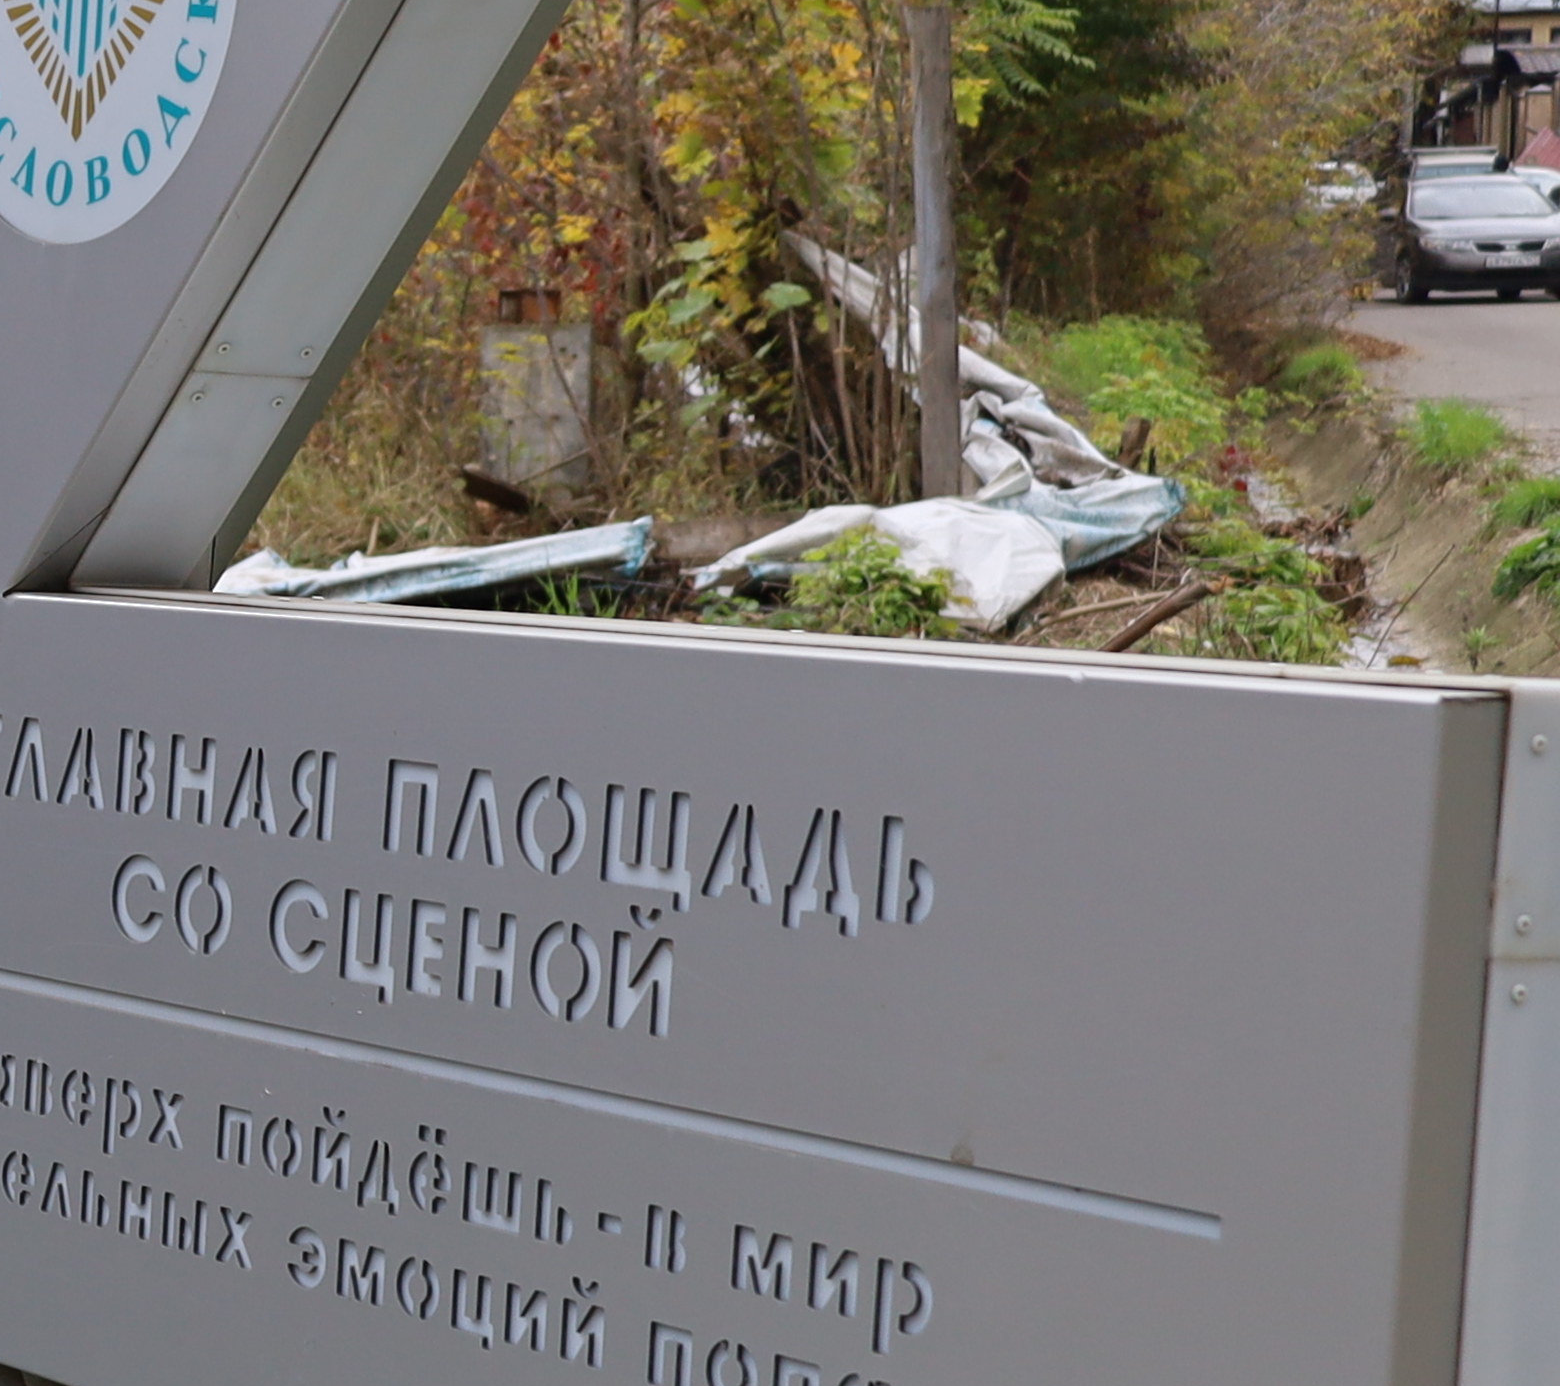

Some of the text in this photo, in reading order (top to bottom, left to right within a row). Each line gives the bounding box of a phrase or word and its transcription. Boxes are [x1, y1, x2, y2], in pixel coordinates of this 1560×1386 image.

[382, 757, 936, 938] ПЛОЩАДЬ
[112, 853, 675, 1039] СО СЦЕНОЙ
[216, 1102, 574, 1246] пойдёшь
[731, 1222, 934, 1356] мир
[286, 1225, 606, 1370] эмоций
